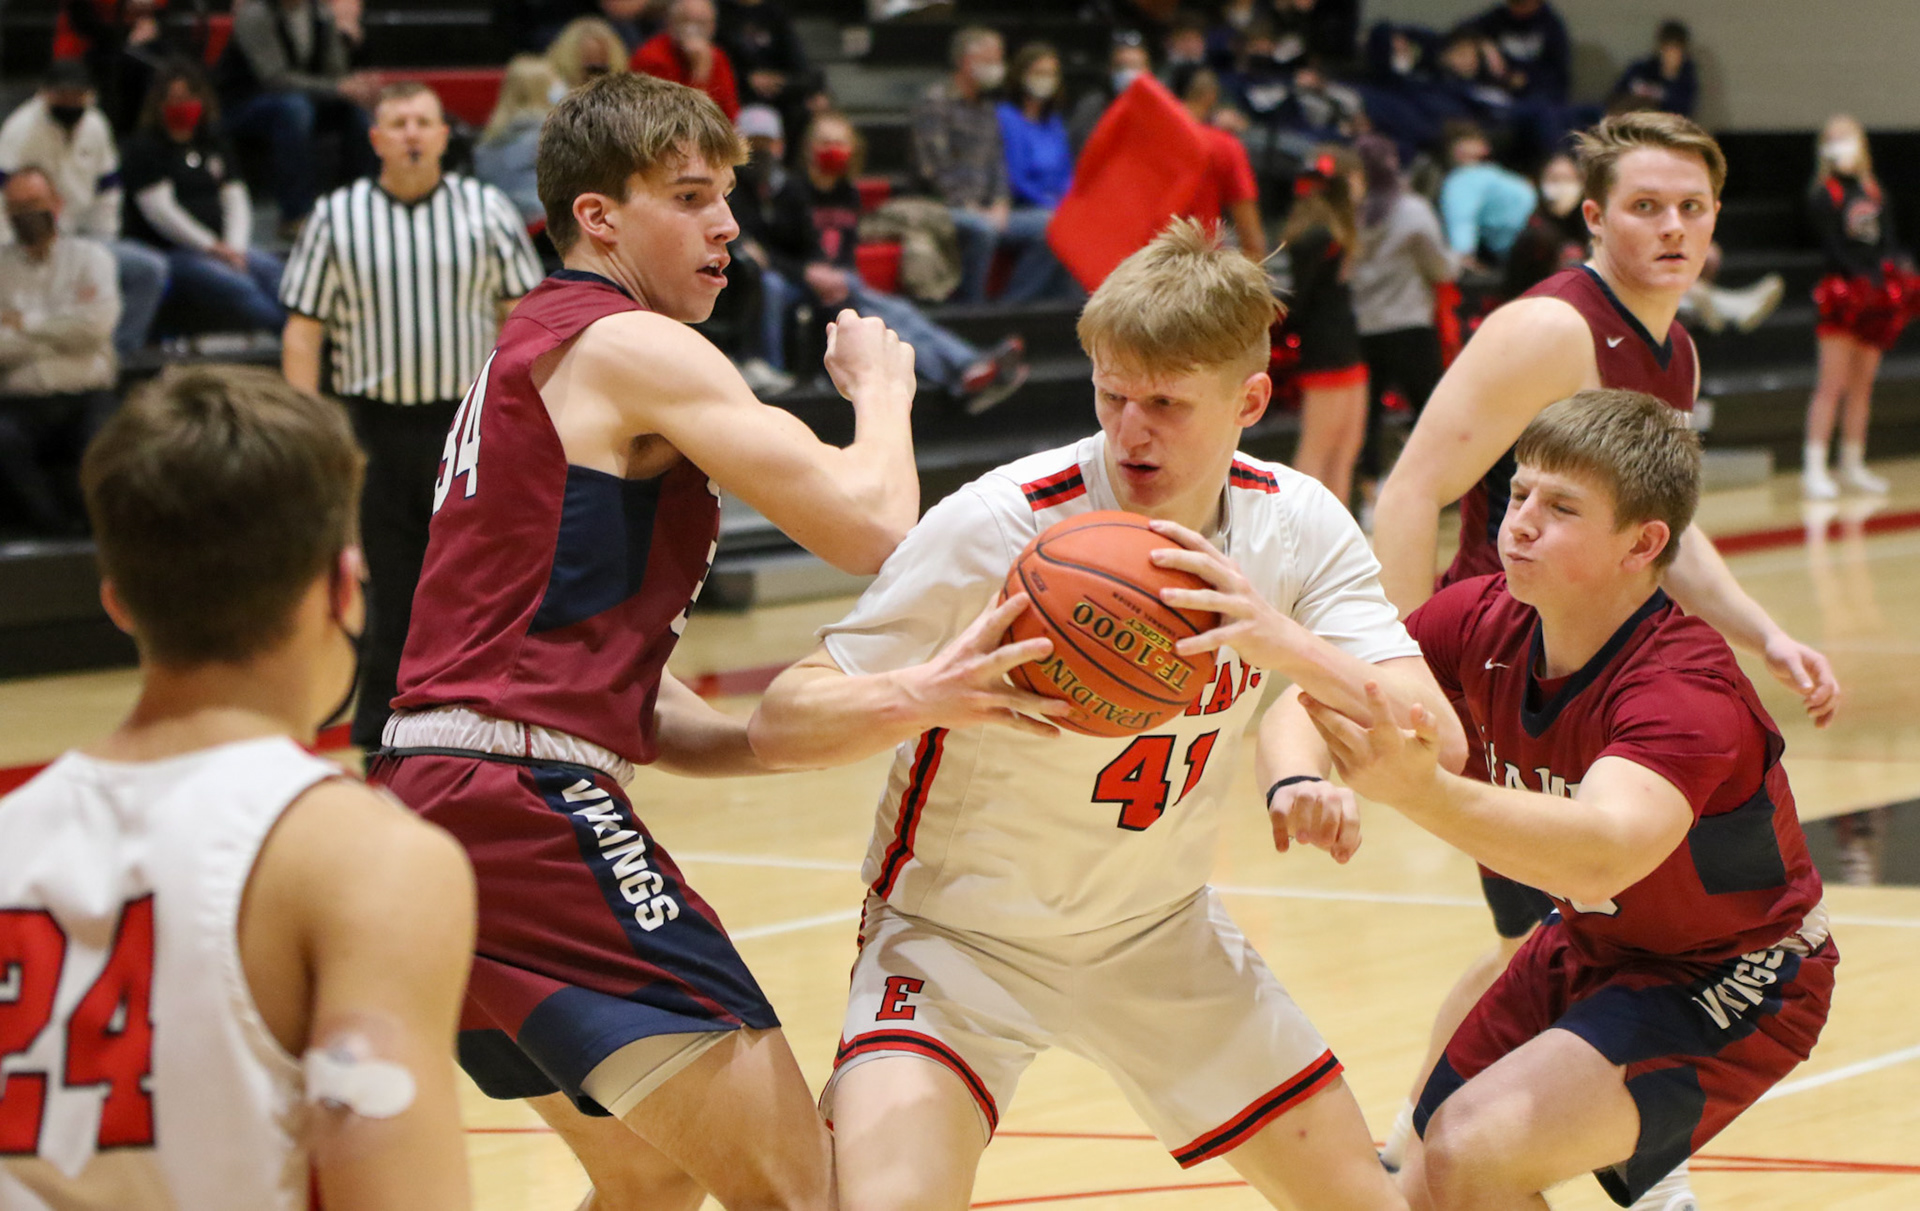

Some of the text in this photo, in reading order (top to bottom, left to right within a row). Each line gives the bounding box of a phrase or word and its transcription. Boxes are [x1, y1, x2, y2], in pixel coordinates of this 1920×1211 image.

[432, 347, 499, 515] 34
[1073, 602, 1193, 692] TF-1000
[1125, 619, 1173, 651] LEGACY
[1091, 727, 1220, 832] 41
[561, 778, 680, 932] VIKINGS
[0, 892, 156, 1156] 24
[875, 976, 925, 1022] E
